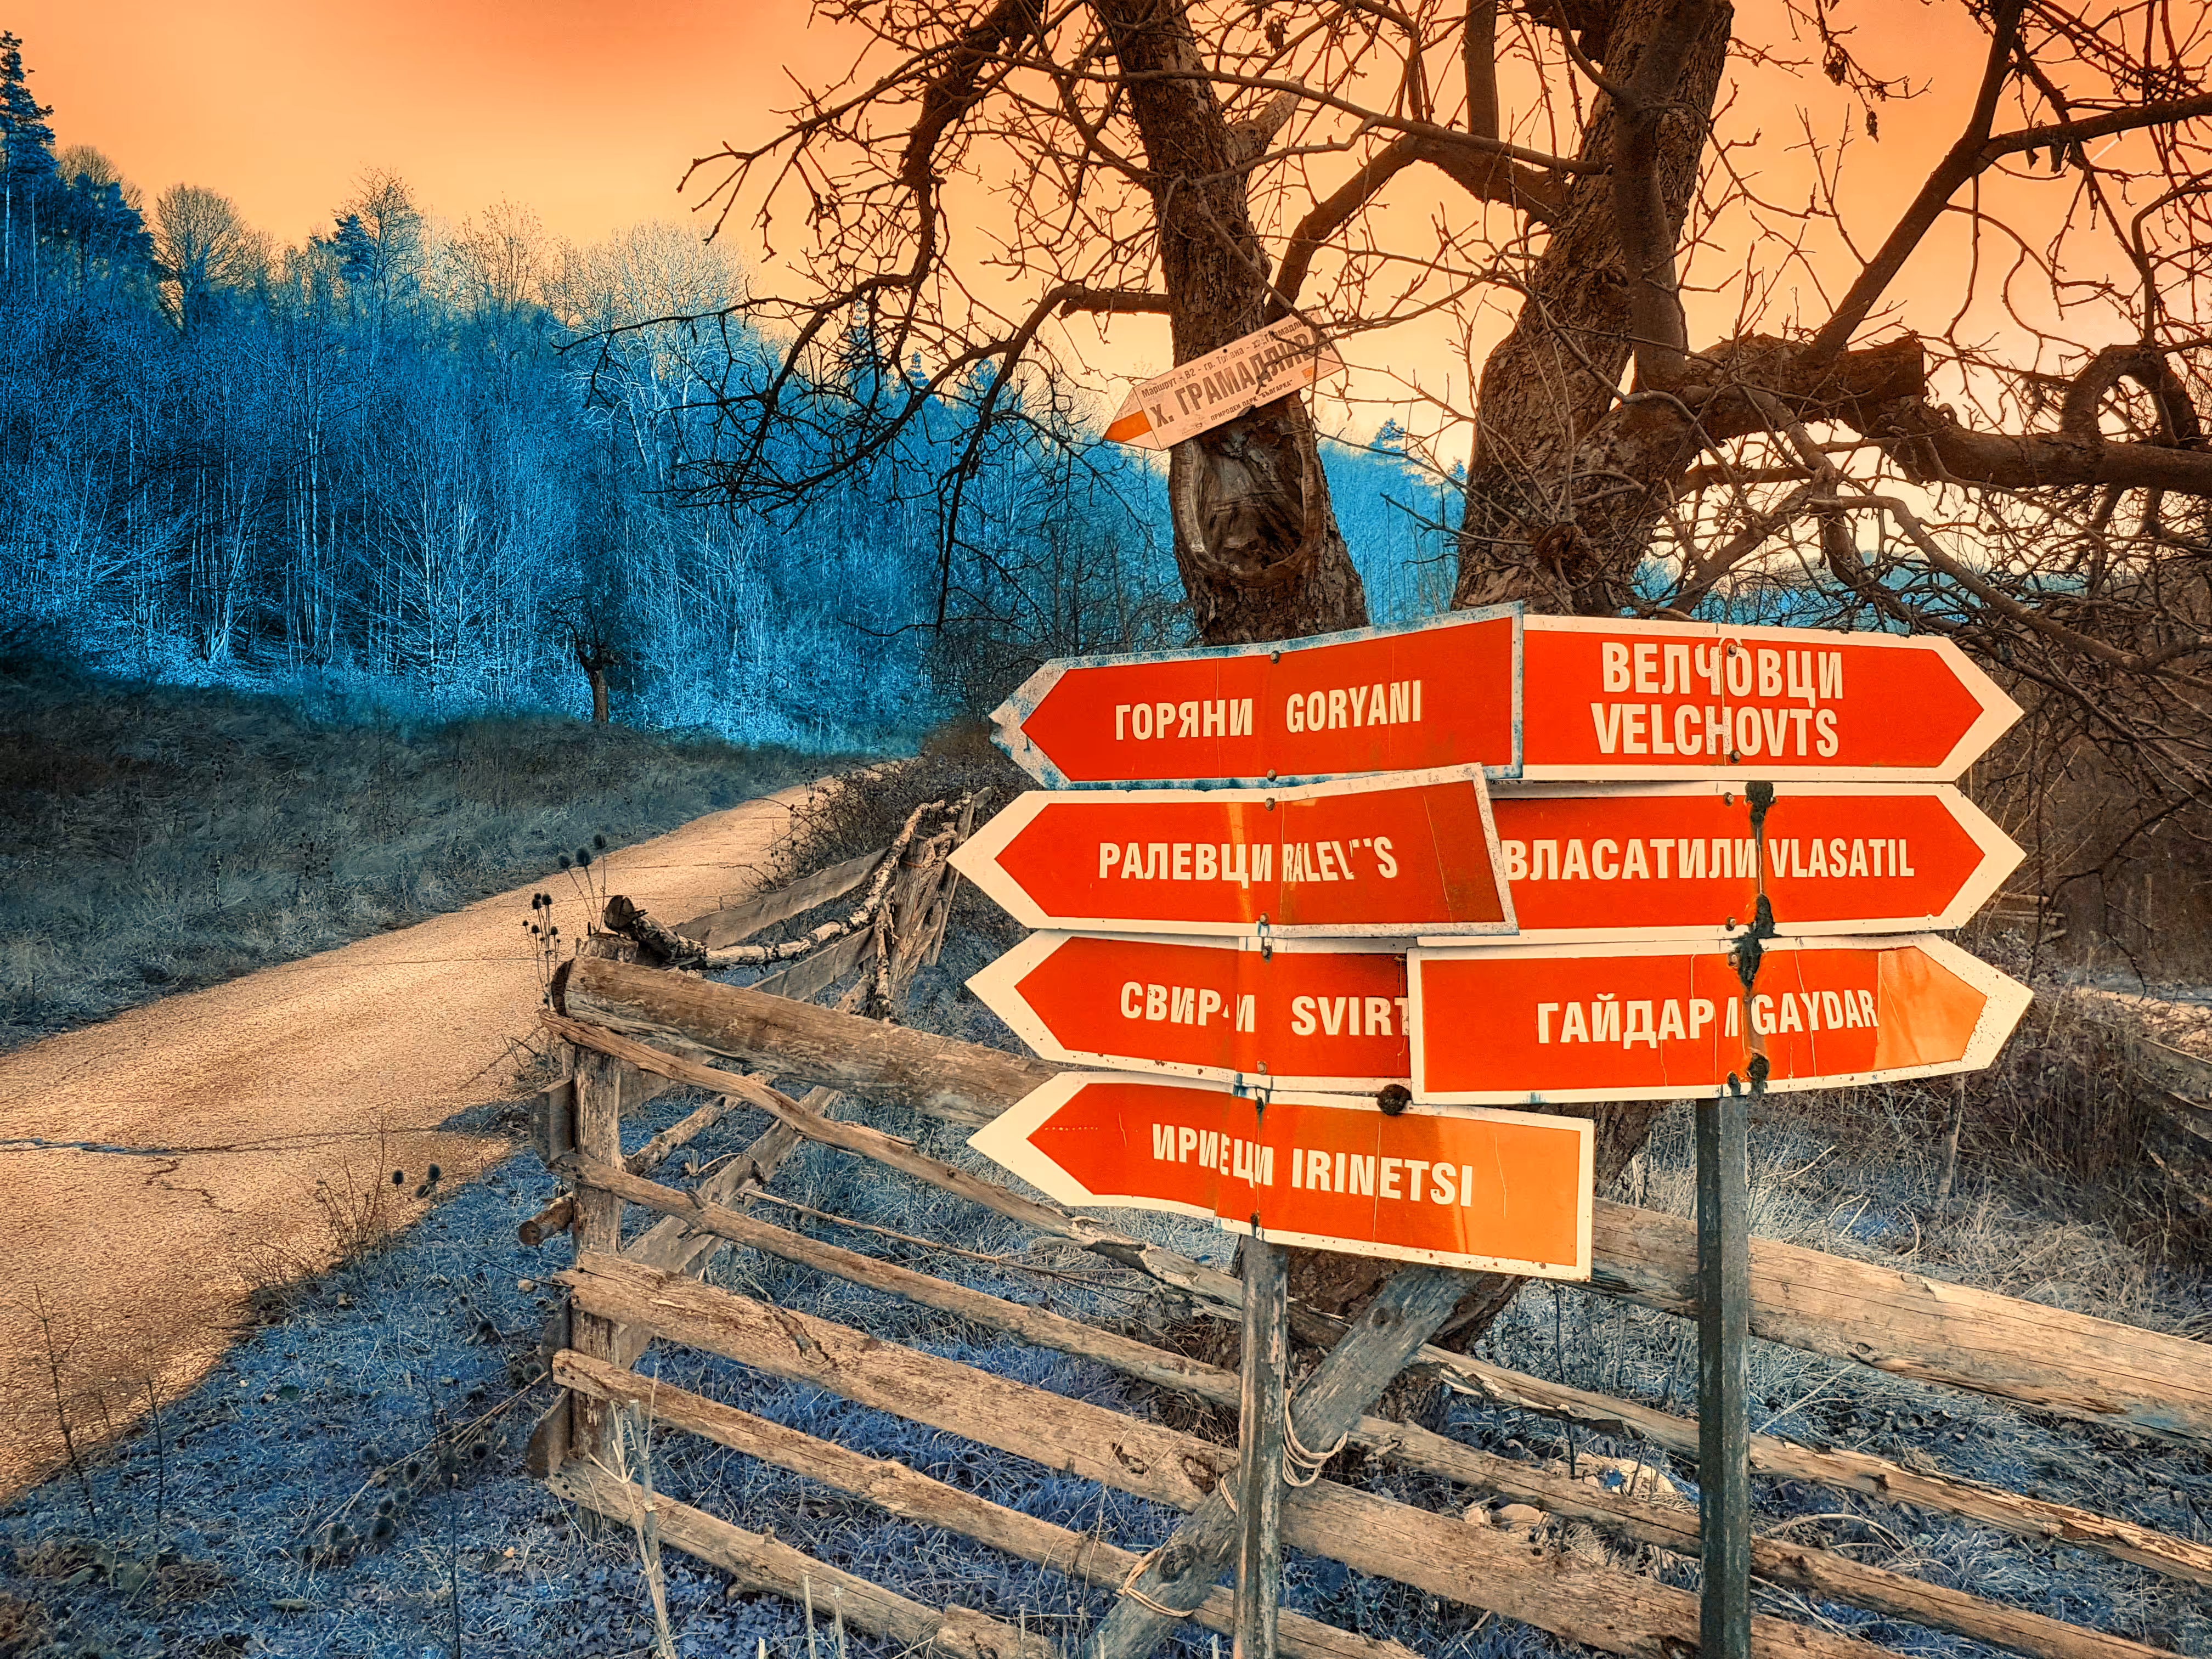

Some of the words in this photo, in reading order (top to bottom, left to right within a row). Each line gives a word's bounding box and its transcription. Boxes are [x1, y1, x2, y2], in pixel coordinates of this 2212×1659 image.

[1141, 377, 1177, 398] Маршрут
[1204, 362, 1216, 371] гр.
[1210, 404, 1242, 421] ПРИРОДЕН
[1242, 396, 1259, 412] ПАРК
[1602, 642, 1843, 708] ВЕЛЧОВЦИ
[1115, 698, 1252, 740] ГОРЯНИ
[1286, 680, 1421, 733] GORYANI
[1590, 703, 1838, 758] VELCHOVTS
[1099, 842, 1272, 889] РАЛЕВЦИ
[1502, 838, 1757, 882] ВЛАСАТИЛИ
[1768, 838, 1915, 878] VLASATIL
[1751, 990, 1880, 1035] GAYDAR
[1291, 1148, 1473, 1207] IRINETSI
